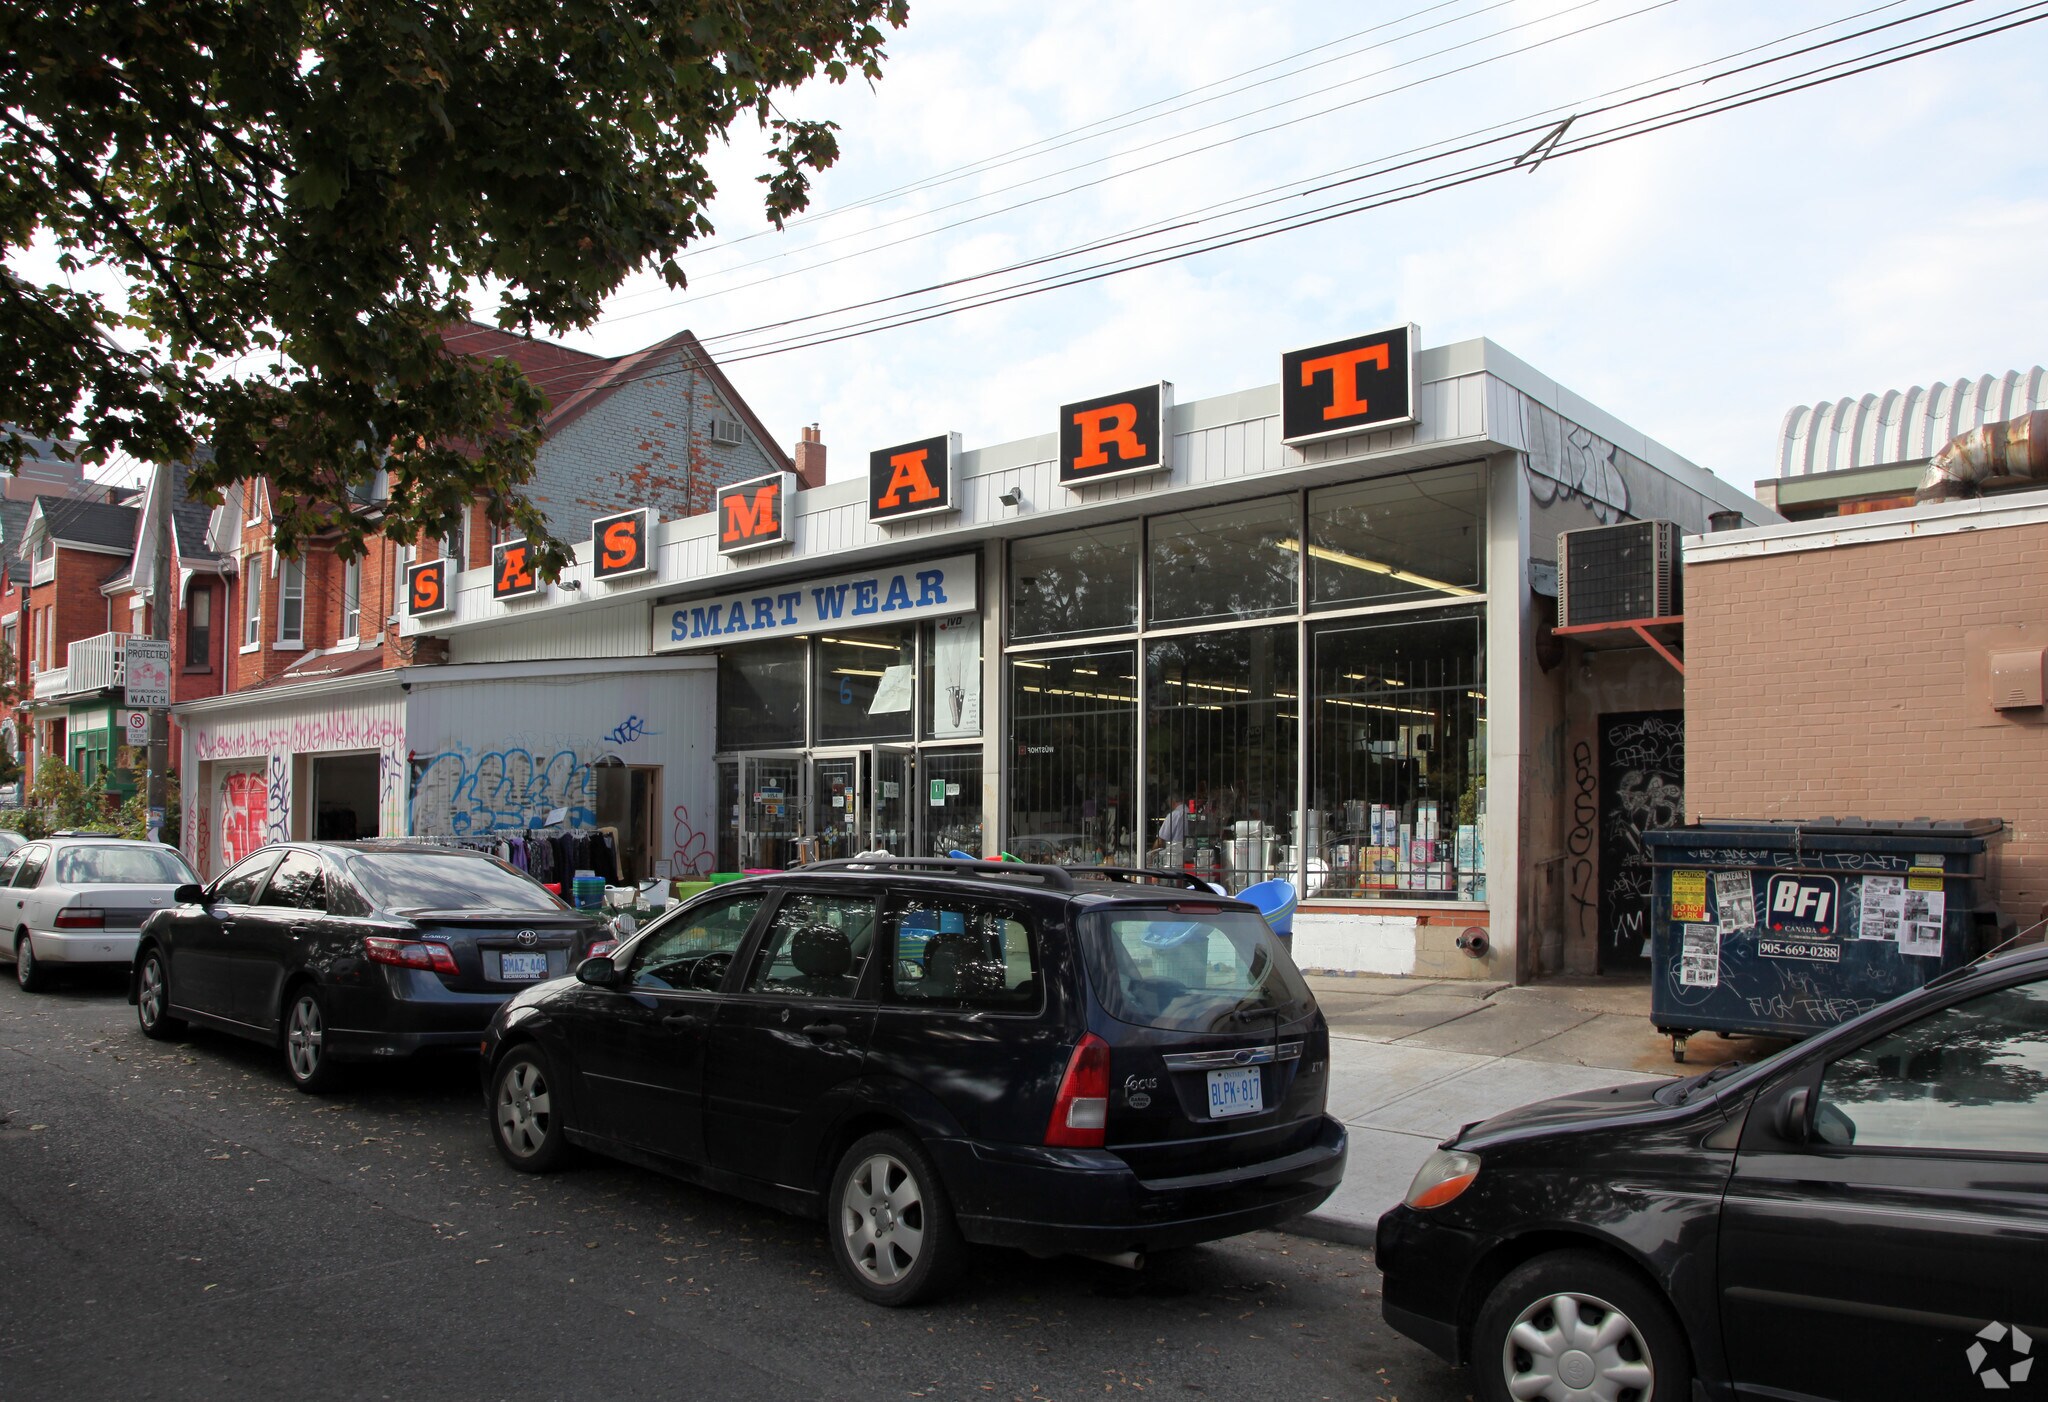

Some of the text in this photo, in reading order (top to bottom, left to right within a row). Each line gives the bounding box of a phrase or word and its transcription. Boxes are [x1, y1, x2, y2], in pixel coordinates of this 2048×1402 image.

[1657, 523, 1668, 559] YORK
[671, 569, 947, 642] SMART WEAR
[128, 649, 169, 660] PROTECTED
[130, 695, 166, 704] WATCH
[1674, 904, 1704, 912] DO NOT
[1773, 880, 1831, 923] BFI
[1677, 911, 1698, 919] PARK
[1784, 925, 1817, 934] CANADA
[1761, 942, 1837, 958] 905-669-0288
[1211, 1078, 1259, 1106] BLPK 817
